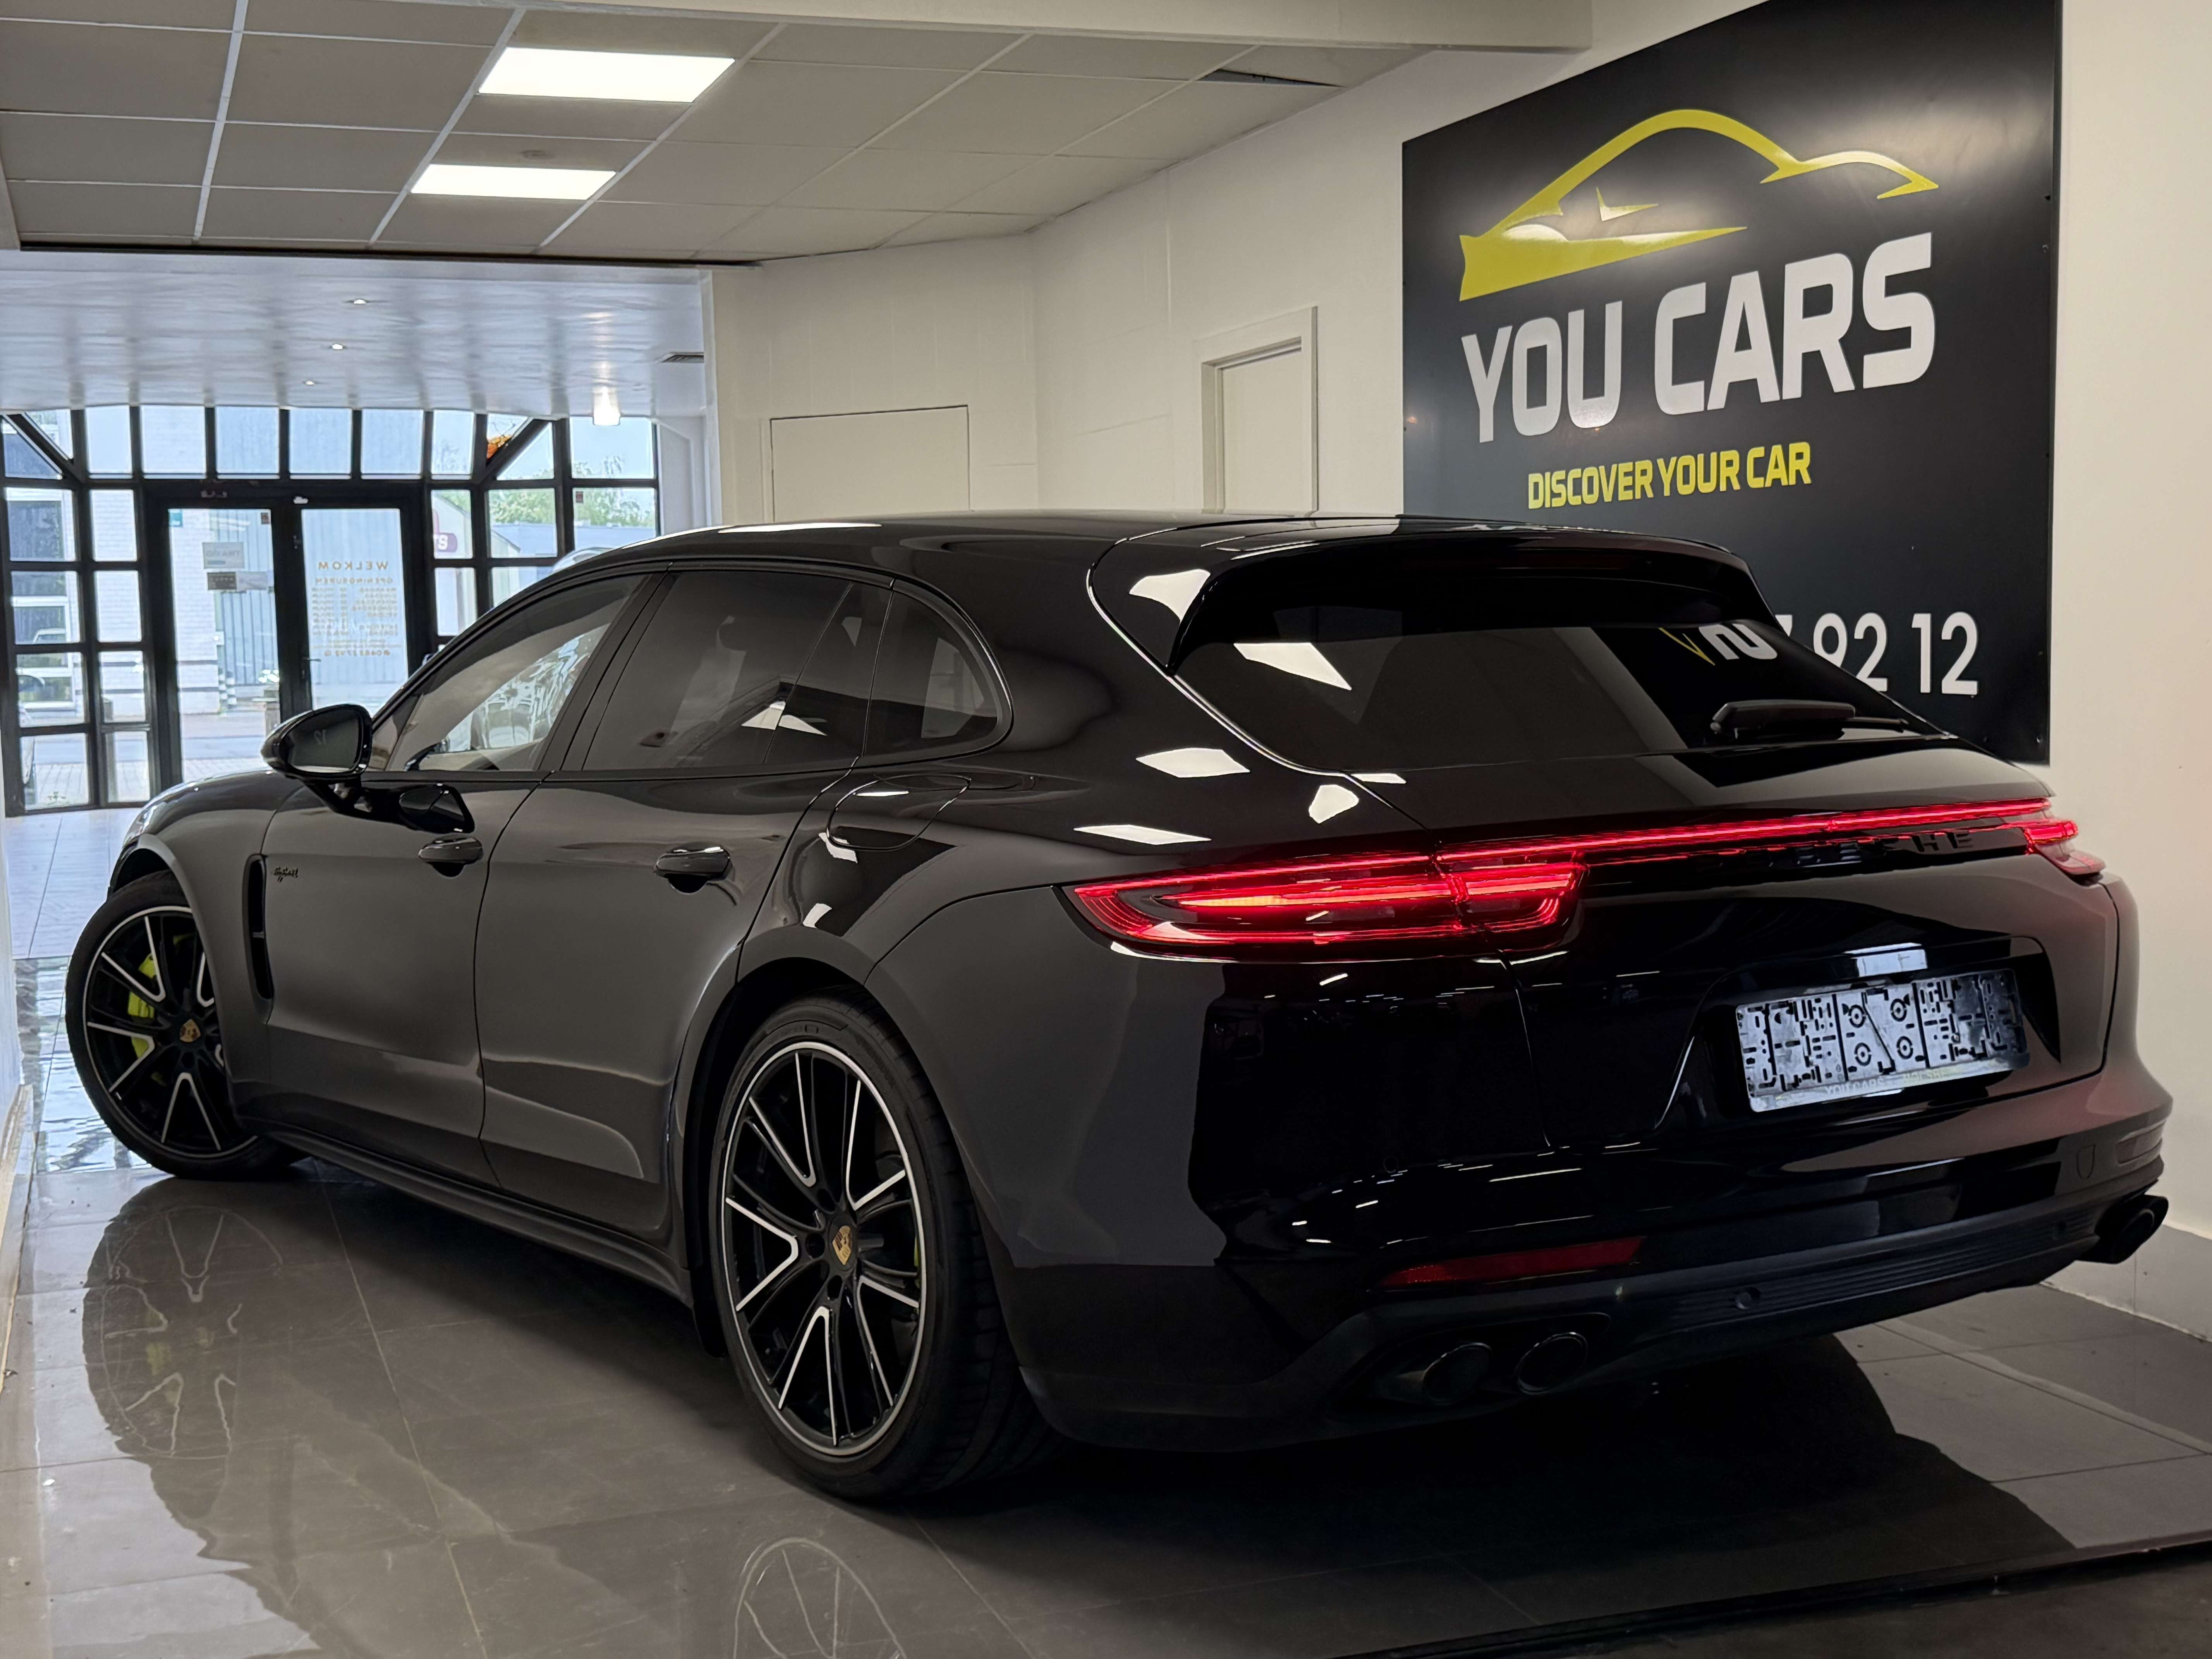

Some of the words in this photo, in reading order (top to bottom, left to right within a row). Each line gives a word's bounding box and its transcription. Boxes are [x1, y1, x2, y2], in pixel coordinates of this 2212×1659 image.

[1461, 300, 1623, 444] YOU
[1654, 232, 1936, 416] CARS
[1528, 459, 1654, 509] DISCOVER
[1658, 452, 1740, 496] YOUR
[1747, 442, 1812, 489] CAR
[1813, 612, 1888, 692] 92
[1911, 612, 1978, 695] 12
